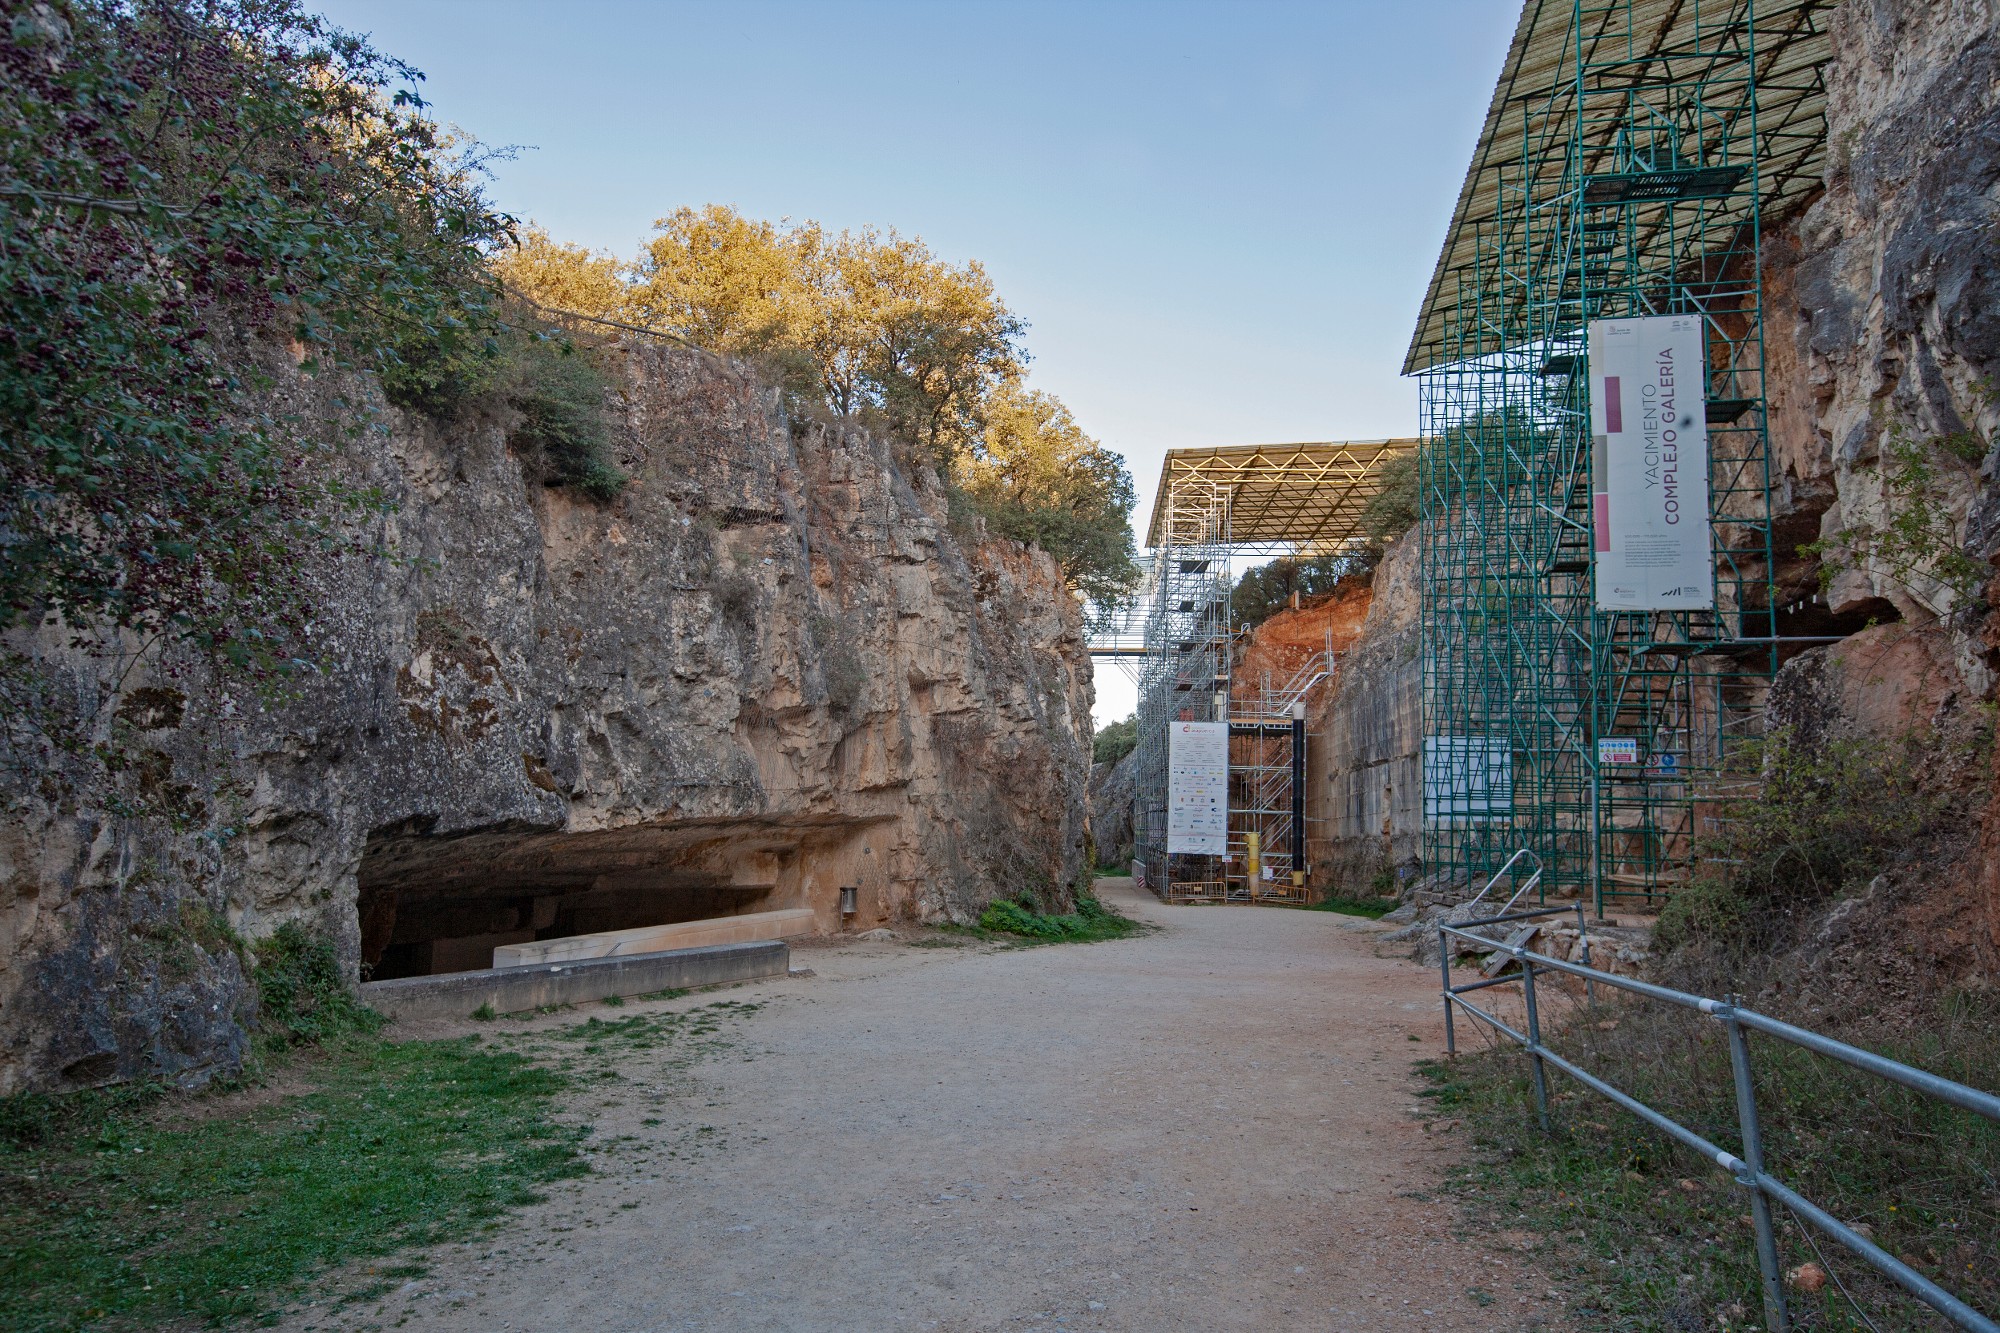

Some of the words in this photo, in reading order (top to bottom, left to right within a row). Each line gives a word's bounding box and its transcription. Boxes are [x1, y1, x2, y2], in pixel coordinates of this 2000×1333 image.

[1656, 347, 1676, 424] GALERÍA
[1642, 384, 1659, 490] YACIMIENTO
[1662, 429, 1680, 525] COMPLEJO
